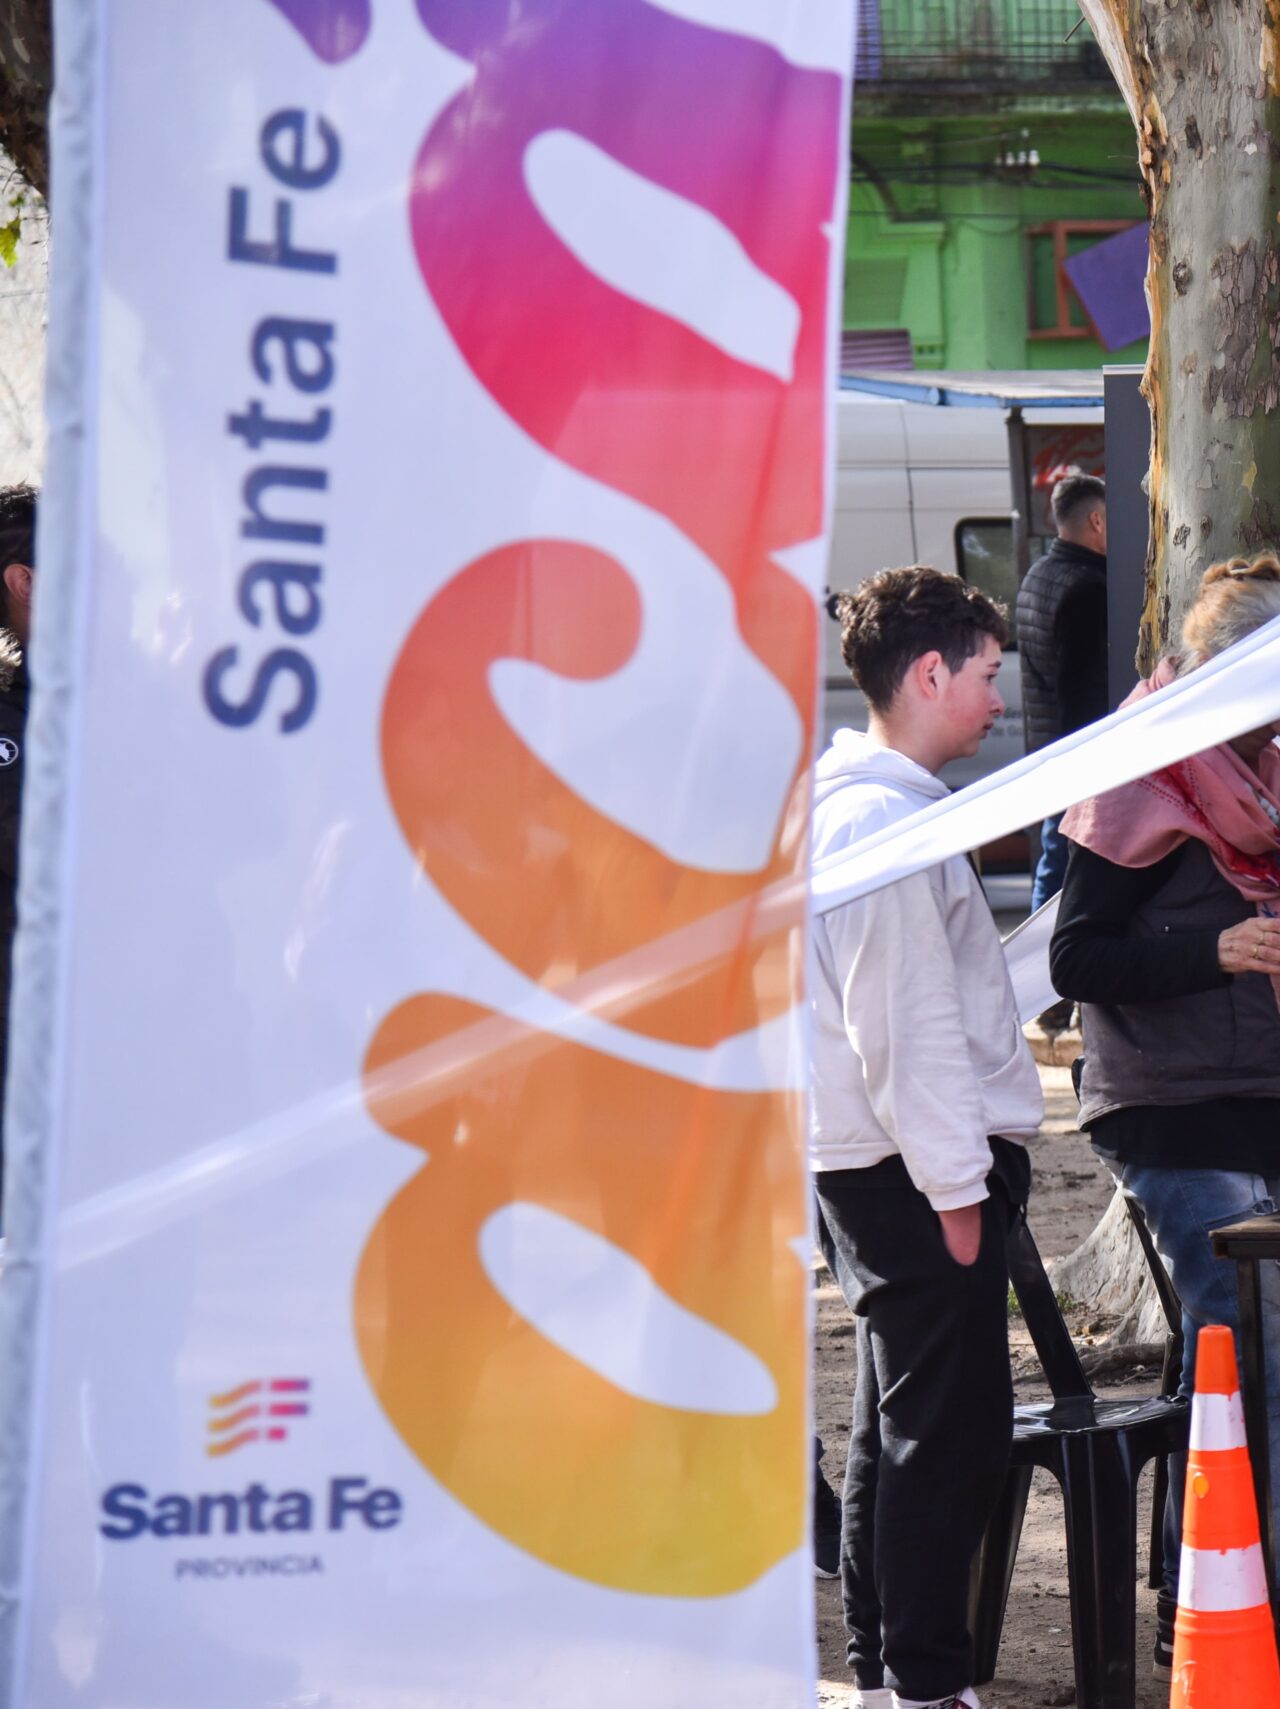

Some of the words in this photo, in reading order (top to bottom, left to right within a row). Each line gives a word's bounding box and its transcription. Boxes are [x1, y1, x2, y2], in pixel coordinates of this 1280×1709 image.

[226, 107, 343, 275] Fe
[202, 313, 336, 736] Santa
[99, 1482, 313, 1540] Santa
[327, 1477, 403, 1531] Fe
[174, 1554, 324, 1580] PROVINCIA
